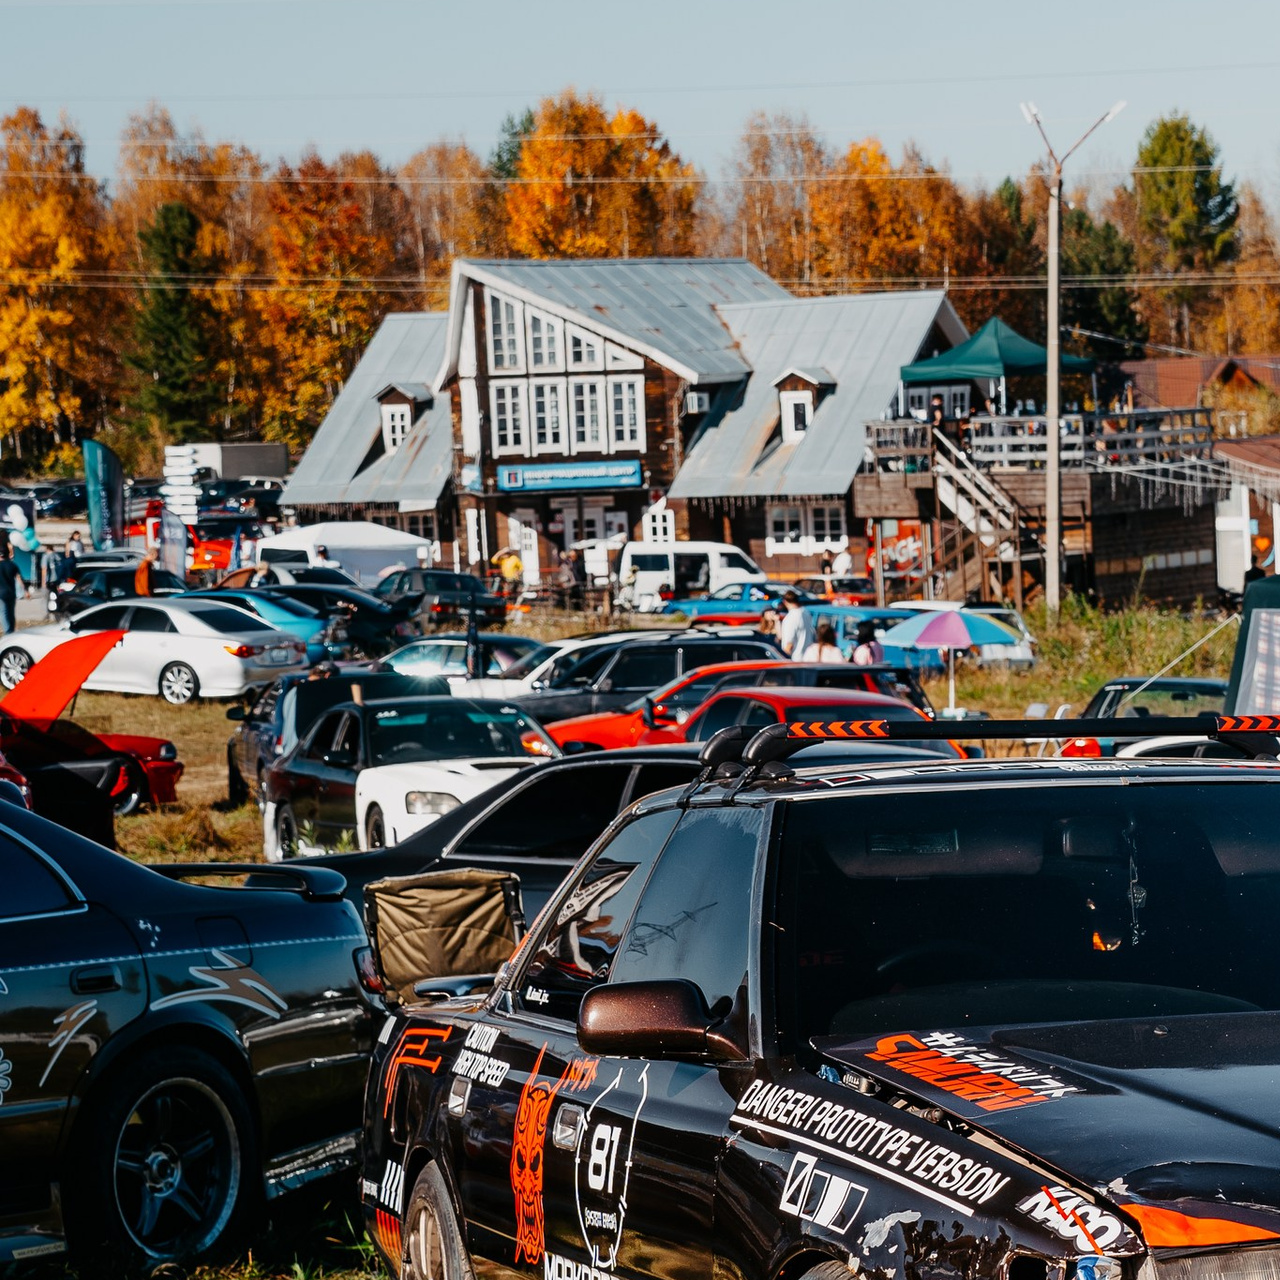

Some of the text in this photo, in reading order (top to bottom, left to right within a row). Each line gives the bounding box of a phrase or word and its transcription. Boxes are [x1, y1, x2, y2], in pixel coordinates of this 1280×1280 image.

[464, 1022, 500, 1053] CAUTION
[484, 1057, 510, 1087] SPEED
[864, 1033, 1050, 1111] SAMURAI
[587, 1123, 622, 1194] 81
[738, 1078, 1011, 1205] DANGER! PROTOTYPE VERSION
